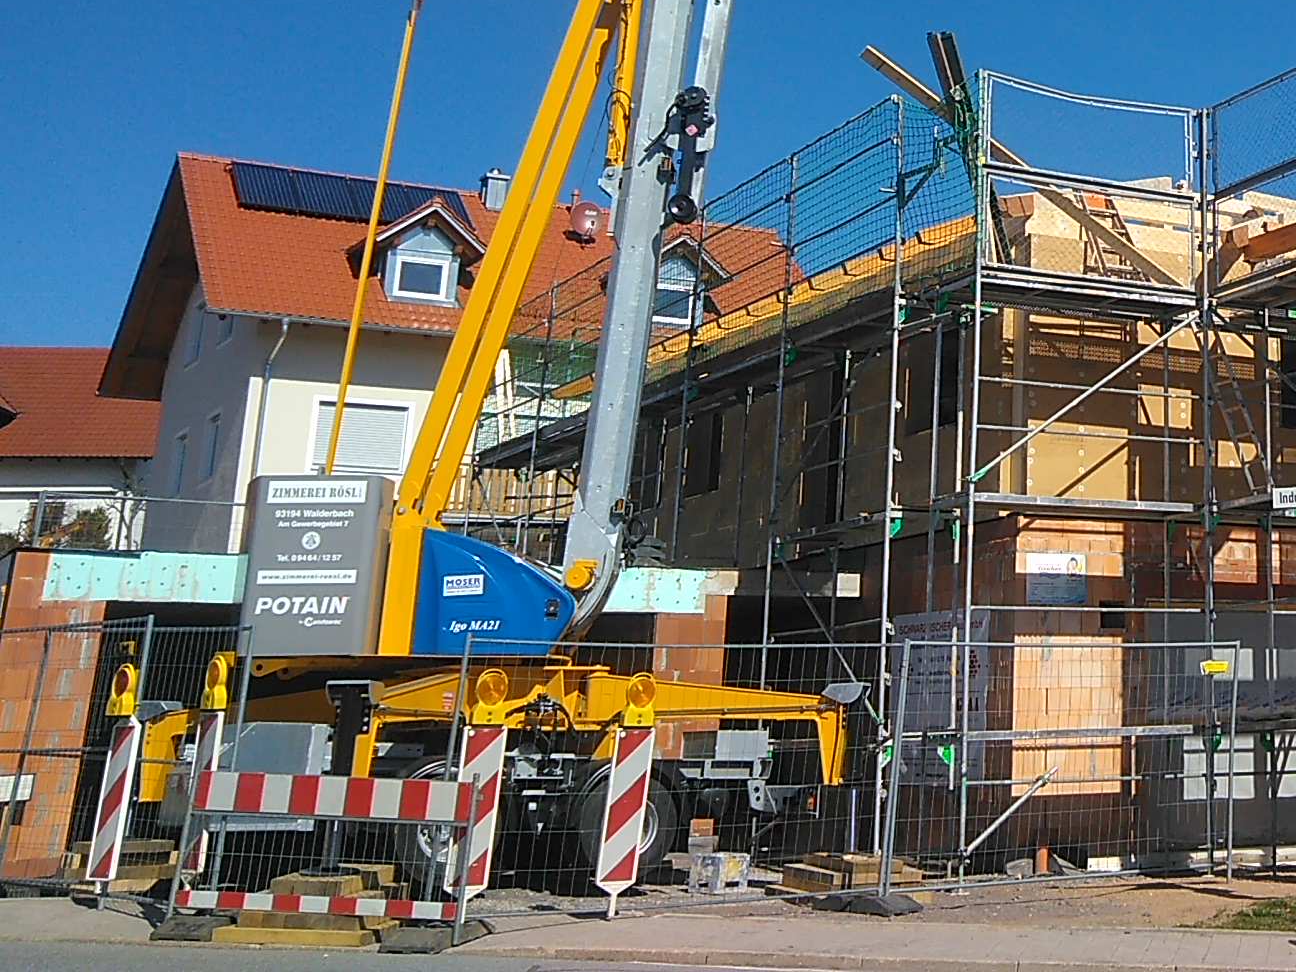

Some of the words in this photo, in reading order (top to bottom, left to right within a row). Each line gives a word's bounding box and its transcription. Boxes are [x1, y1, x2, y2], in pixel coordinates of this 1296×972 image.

[271, 487, 327, 498] ZIMMEREI
[329, 485, 358, 498] RÖSL
[275, 509, 301, 518] 93194
[303, 509, 354, 518] Walderbach
[291, 520, 343, 528] Gewerbegebiet
[446, 577, 481, 587] MOSER
[254, 596, 350, 615] POTAIN
[449, 620, 467, 633] Igo
[468, 620, 500, 630] MA21
